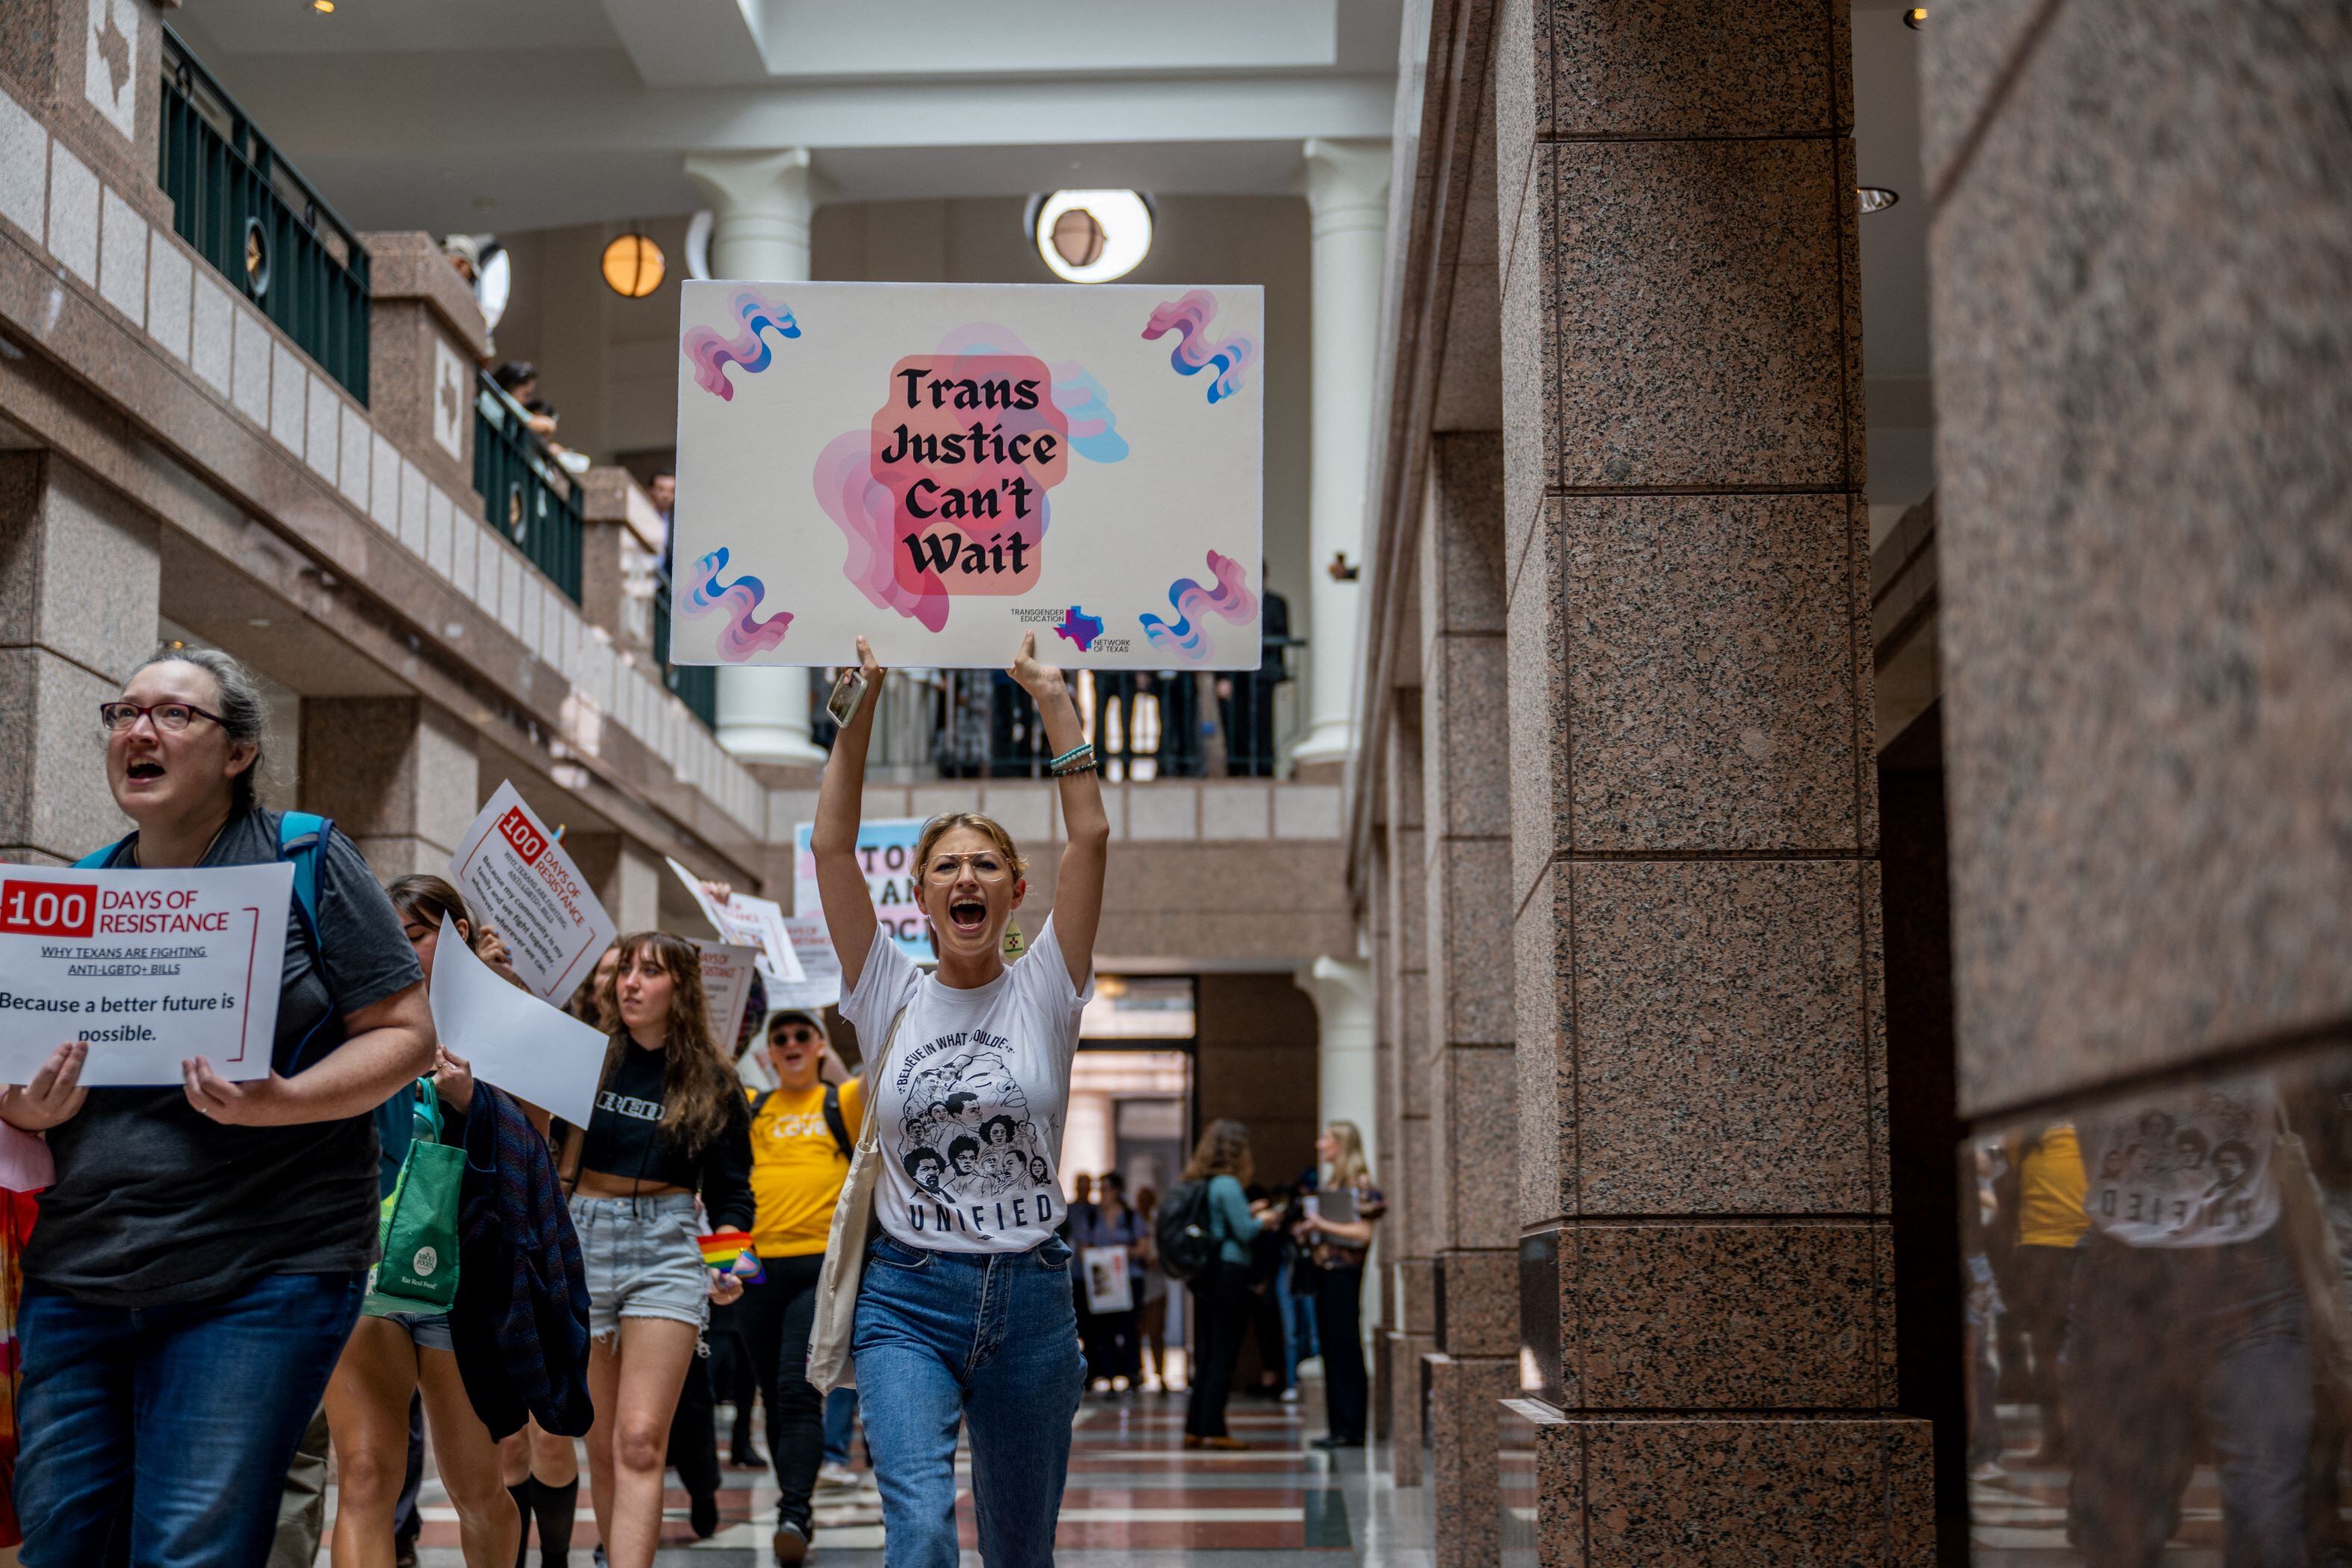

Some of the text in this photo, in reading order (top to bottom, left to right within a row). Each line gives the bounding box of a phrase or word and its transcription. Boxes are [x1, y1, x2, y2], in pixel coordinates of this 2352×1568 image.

[897, 368, 1041, 410] Trans
[881, 421, 1057, 465] Justice
[905, 476, 1033, 520] Can't
[902, 531, 1030, 574] Wait
[1010, 608, 1065, 616] TRANSGENDER
[1020, 615, 1065, 623] EDUCATION
[1093, 638, 1131, 647] NETWORK
[1093, 645, 1130, 653] OF TEXAS
[503, 815, 541, 857] 100
[535, 860, 585, 928] RESISTANCE
[544, 850, 582, 900] DAYS OF
[7, 890, 87, 929] 100
[102, 890, 199, 909] DAYS OF
[482, 856, 564, 959] Because my community is my
[491, 889, 503, 906] and
[502, 904, 514, 917] we
[512, 914, 530, 935] fight
[99, 912, 230, 933] RESISTANCE
[41, 945, 206, 959] WHY TEXANS ARE FIGHTING
[68, 963, 181, 976] ANTI-LGBTQ+ BILLS
[524, 947, 536, 959] we
[0, 992, 234, 1012] Because a better future is
[897, 1048, 926, 1086] BELIEVE
[922, 1042, 937, 1057] IN
[935, 1032, 968, 1051] WHAT
[968, 1029, 1002, 1048] OULD
[909, 1194, 1053, 1232] UNIFIED
[411, 1278, 423, 1287] Real
